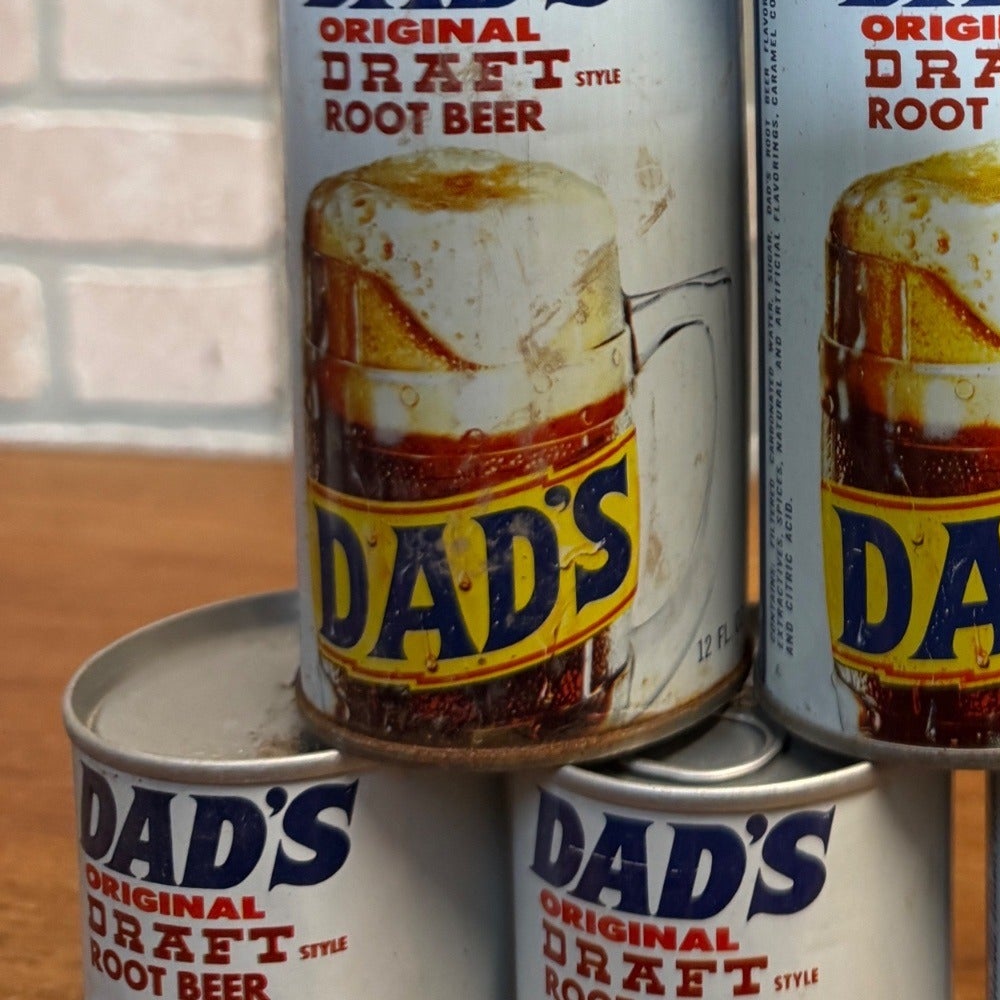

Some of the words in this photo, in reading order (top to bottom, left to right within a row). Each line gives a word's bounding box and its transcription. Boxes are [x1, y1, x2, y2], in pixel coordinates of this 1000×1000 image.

[319, 17, 540, 45] ORIGINAL
[321, 49, 570, 93] DRAFT
[574, 68, 621, 87] STYLE
[769, 29, 778, 106] CARAMEL
[325, 99, 430, 134] ROOT
[442, 100, 545, 135] BEER
[868, 97, 989, 131] ROOT
[773, 233, 782, 327] ARTIFICIAL
[775, 379, 783, 454] NATURAL
[784, 498, 793, 544] ACID.
[315, 452, 631, 661] DAD'S
[784, 553, 793, 612] CITRIC
[697, 634, 712, 663] 12
[785, 621, 794, 656] AND
[80, 760, 359, 891] DAD'S
[530, 786, 836, 923] DAD'S
[86, 864, 265, 921] ORIGINAL
[540, 888, 739, 953] ORIGINAL
[88, 894, 295, 965] DRAFT
[298, 935, 348, 961] STYLE
[542, 920, 768, 998] DRAFT
[774, 968, 818, 992] STYLE
[90, 937, 166, 996] ROOT
[177, 970, 271, 1000] BEER
[545, 964, 636, 1000] RO
